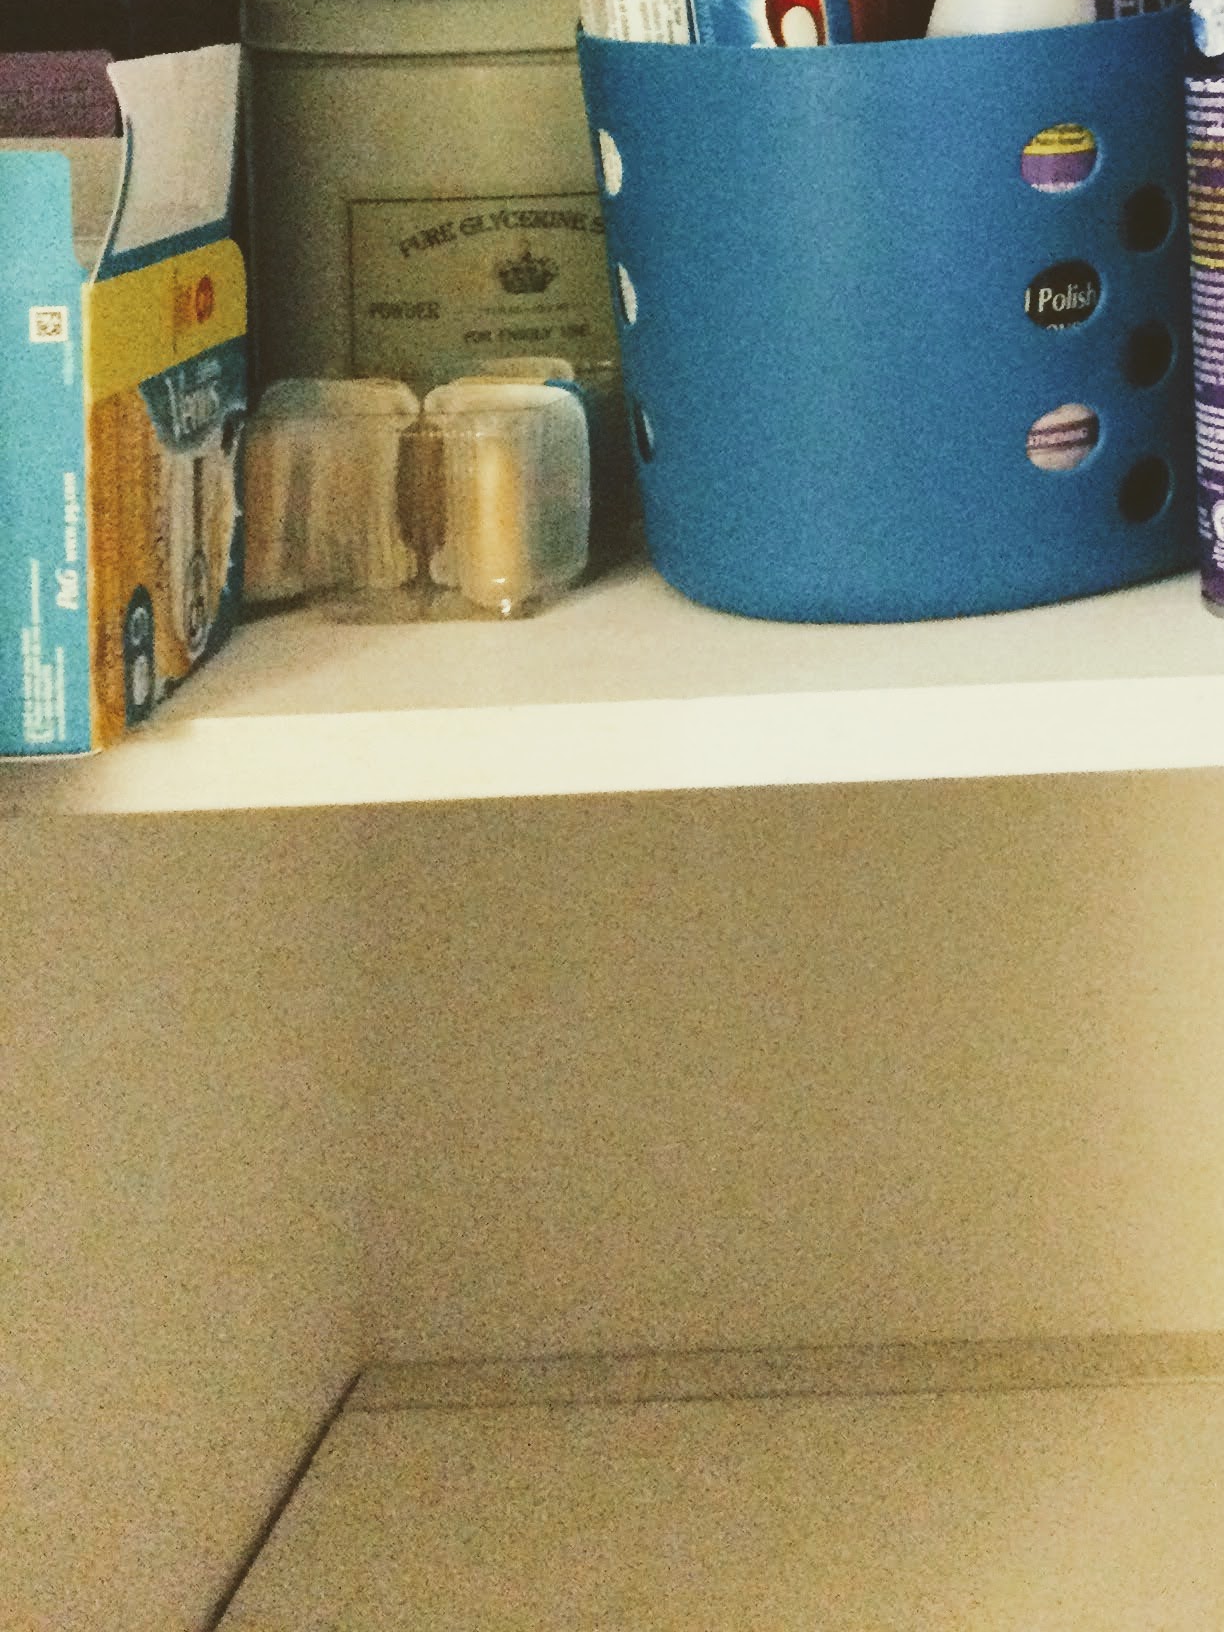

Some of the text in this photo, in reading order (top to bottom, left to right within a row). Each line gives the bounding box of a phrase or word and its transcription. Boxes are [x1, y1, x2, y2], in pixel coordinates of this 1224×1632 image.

[399, 221, 457, 258] PURE
[459, 209, 589, 236] GLYCERINE
[367, 301, 441, 319] POWDER
[1037, 281, 1097, 313] Polish
